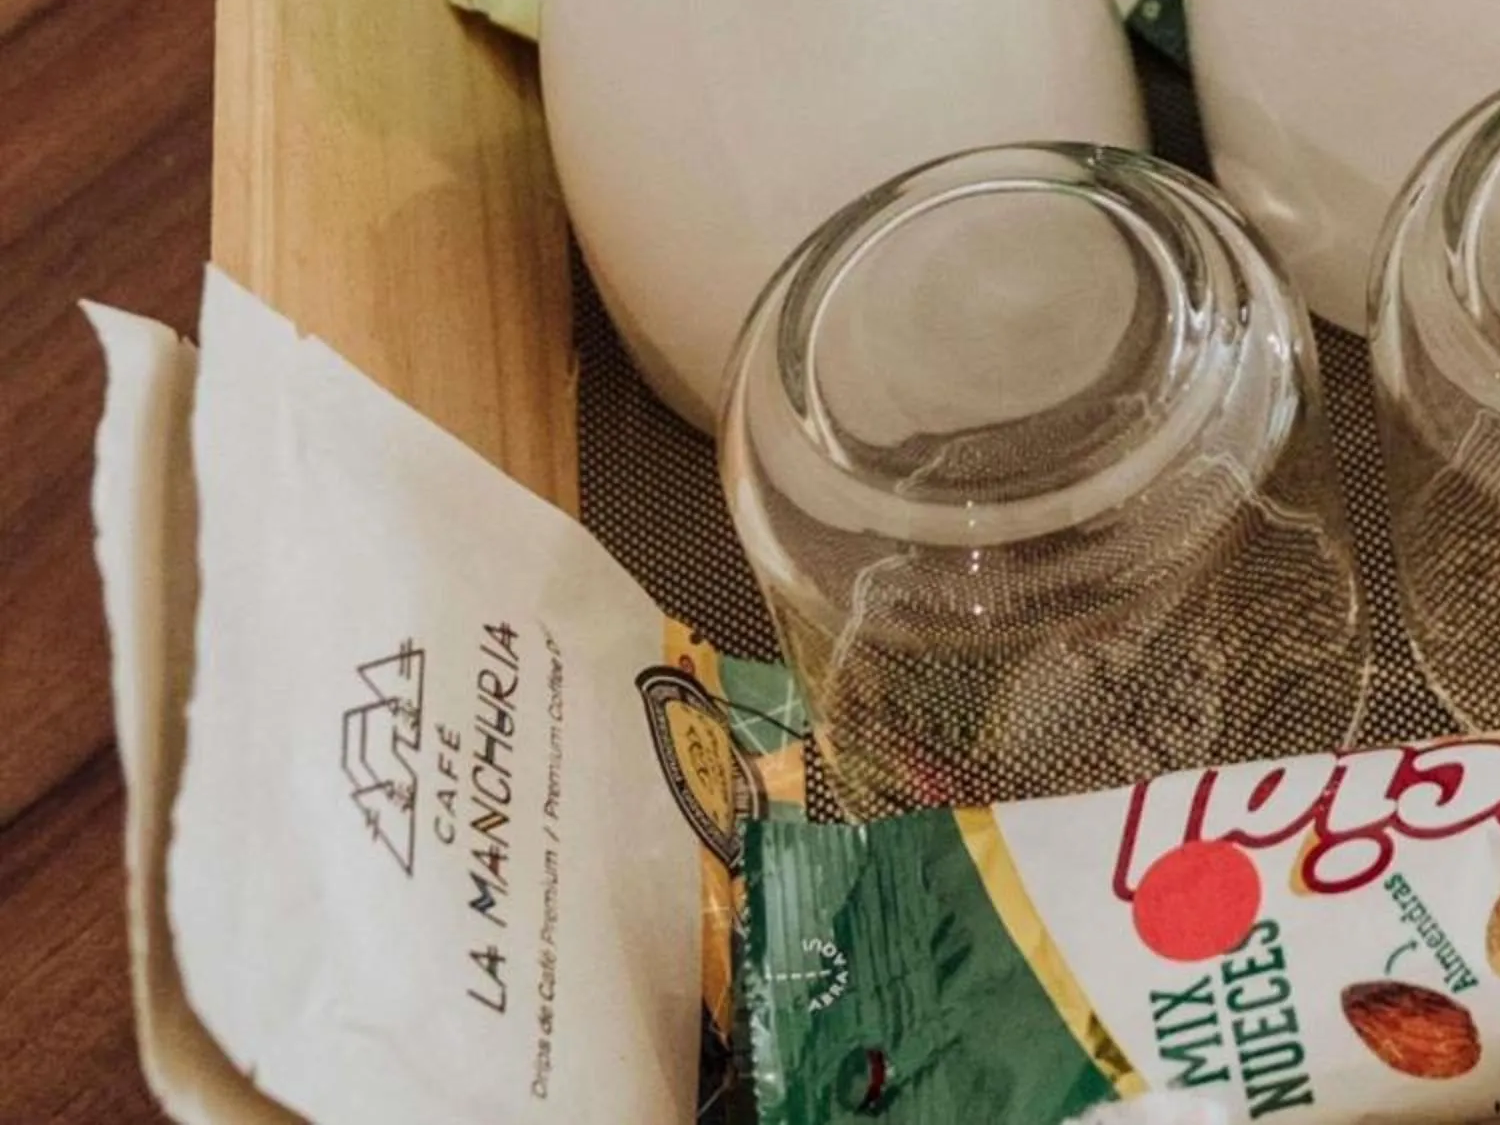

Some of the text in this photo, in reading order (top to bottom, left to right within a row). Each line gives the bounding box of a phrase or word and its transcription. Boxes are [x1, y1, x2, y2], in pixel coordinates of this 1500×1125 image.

[434, 723, 461, 845] CAFÉ
[467, 622, 520, 1015] LA MANCHURIA
[544, 725, 562, 821] Premium
[541, 848, 559, 946] Premium
[1383, 871, 1479, 995] Almendras
[538, 1005, 554, 1036] de
[1149, 975, 1231, 1089] MIX
[1221, 918, 1316, 1120] NUECES
